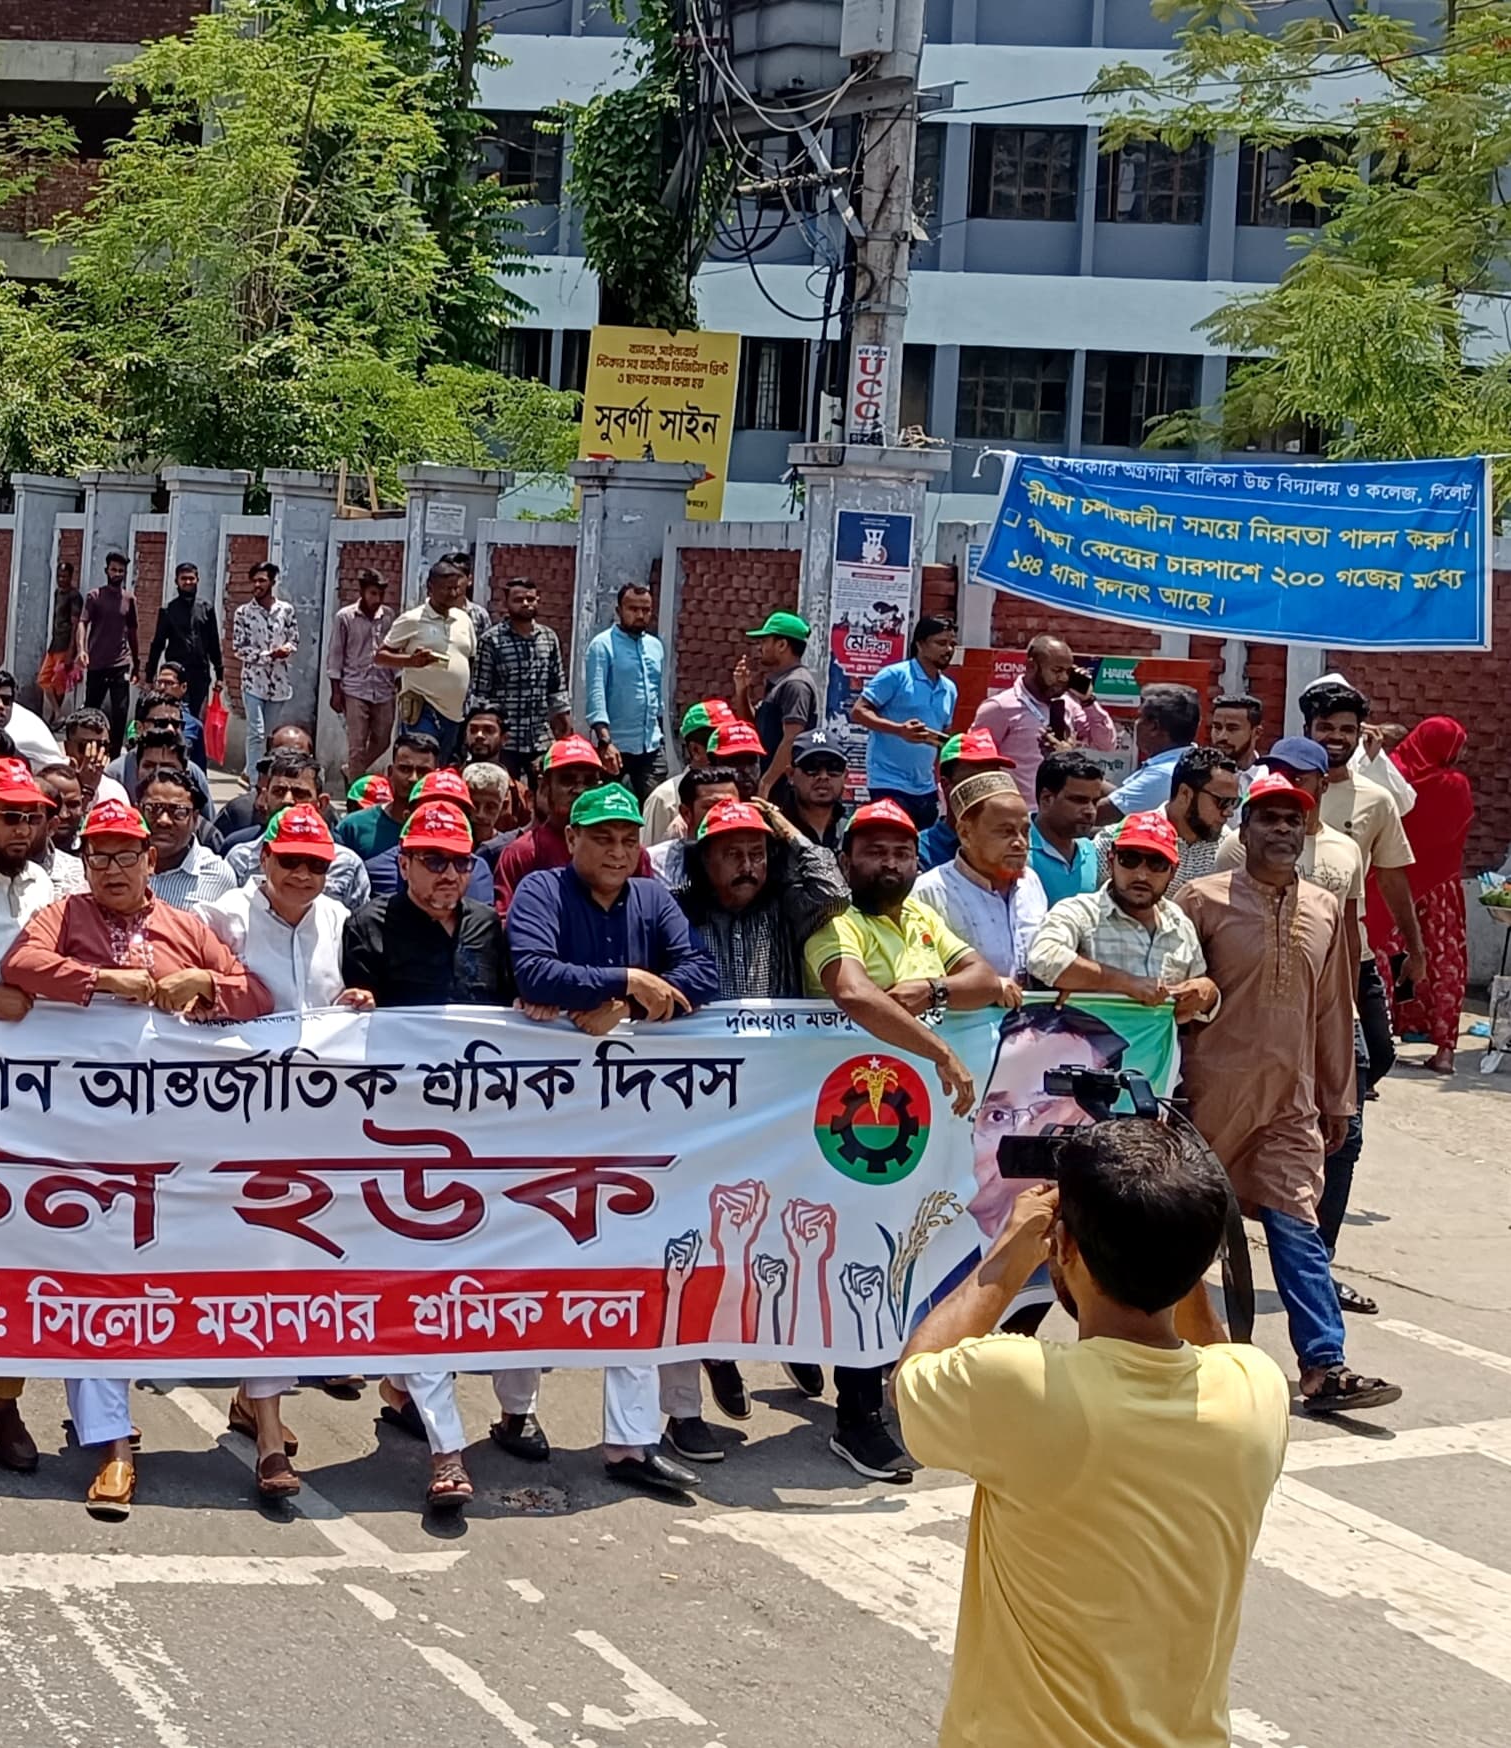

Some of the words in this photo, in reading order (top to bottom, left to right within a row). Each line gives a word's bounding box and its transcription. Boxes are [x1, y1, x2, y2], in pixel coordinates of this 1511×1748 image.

[594, 396, 653, 445] সুবর্ণা
[658, 400, 721, 444] সাইন
[1186, 467, 1239, 488] বালিকা
[1243, 470, 1274, 489] উচ্চ
[1277, 472, 1341, 496] বিদ্যালয়
[1347, 483, 1359, 498] ও
[1365, 482, 1422, 504] কলেজ,
[1026, 480, 1075, 515] রীক্ষা
[1081, 498, 1177, 534] চলাকালীন
[1182, 515, 1243, 541] সময়ে
[1248, 516, 1332, 548] নিরবতা
[1338, 528, 1399, 550] পালন
[1007, 549, 1044, 577] ১৪৪
[1050, 562, 1089, 590] ধারা
[1093, 575, 1152, 605] বলবৎ
[1081, 538, 1159, 571] কেন্দ্রের
[1166, 553, 1264, 583] চারপাশে
[1270, 566, 1325, 589] ২০০
[1336, 567, 1404, 592] গজের
[1410, 568, 1466, 591] মধ্যে
[994, 661, 1027, 673] KONK
[726, 1009, 795, 1034] দুনিয়ার
[806, 1010, 858, 1032] মজদু
[73, 1045, 406, 1123] আন্তর্জাতিক
[416, 1039, 581, 1111] শ্রমিক
[593, 1040, 745, 1111] দিবস
[210, 1118, 679, 1261] হউক
[26, 1276, 183, 1347] সিলেট
[191, 1289, 382, 1352] মহানগর
[409, 1275, 550, 1340] শ্রমিক
[557, 1288, 646, 1340] দল
